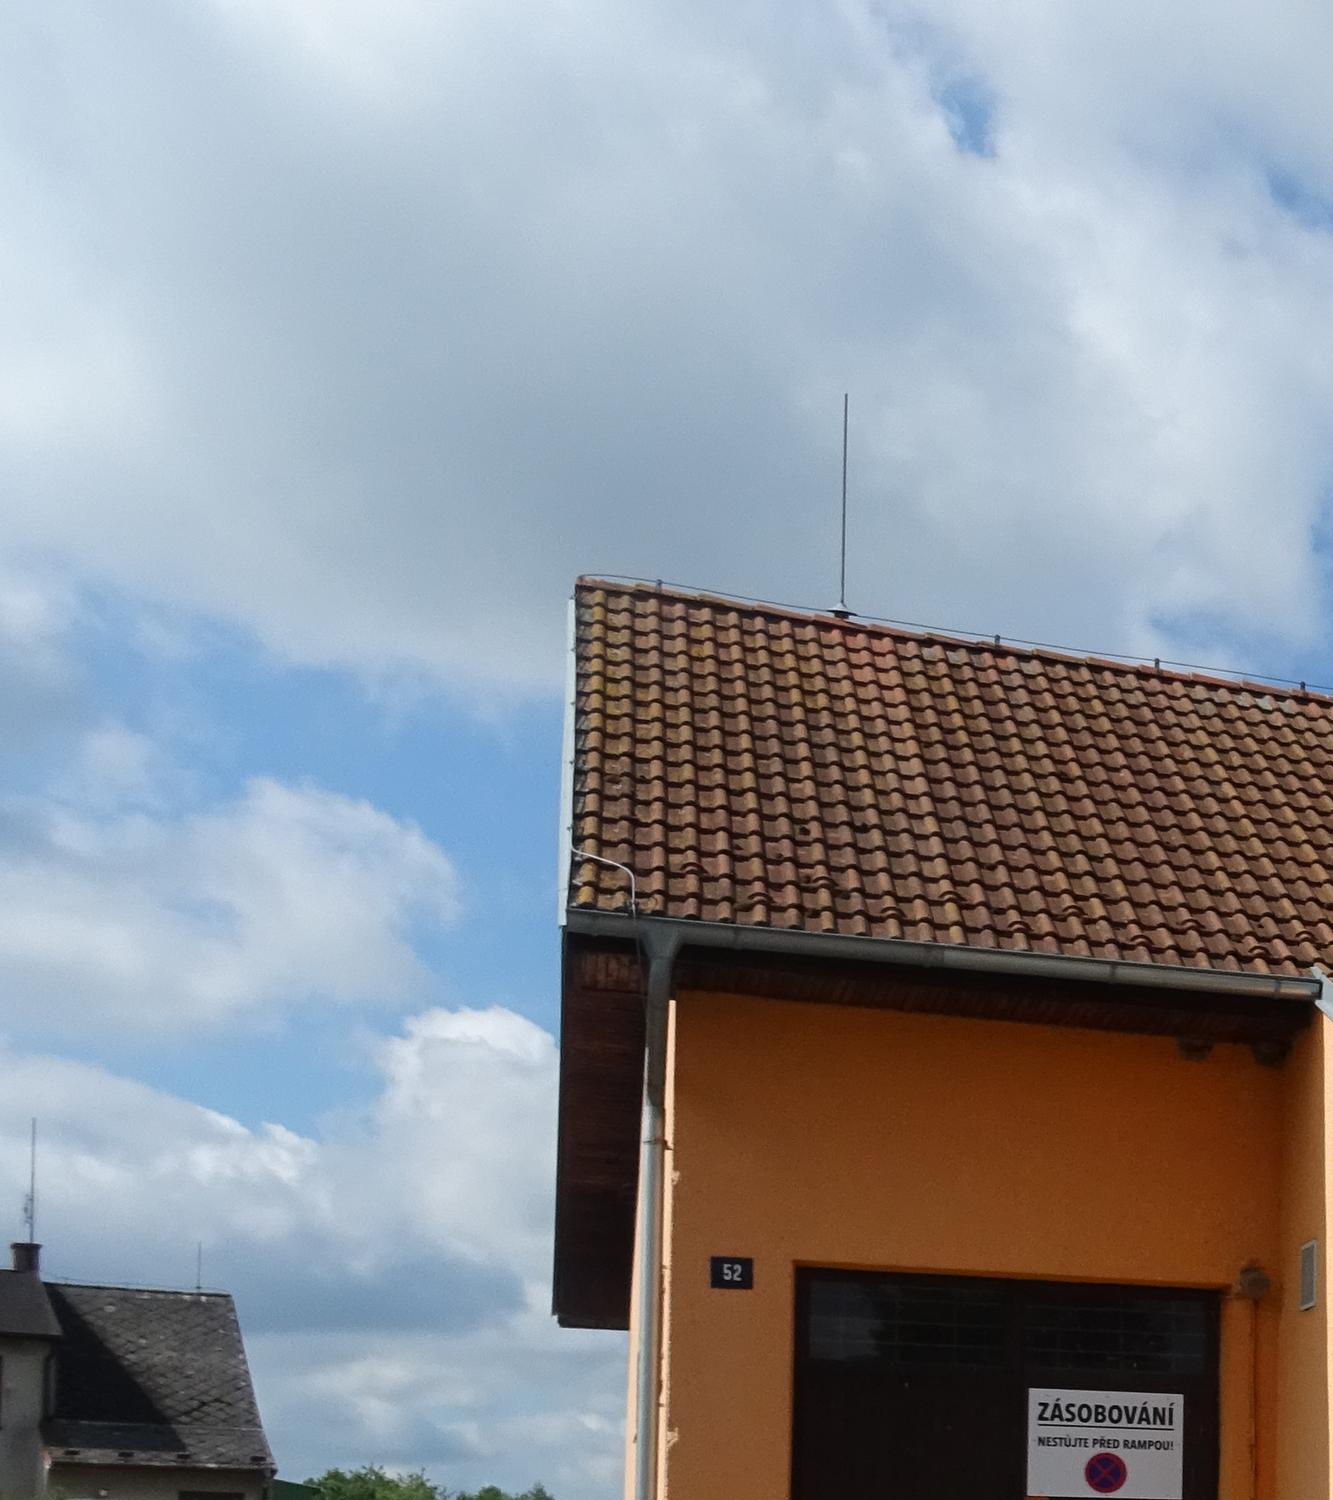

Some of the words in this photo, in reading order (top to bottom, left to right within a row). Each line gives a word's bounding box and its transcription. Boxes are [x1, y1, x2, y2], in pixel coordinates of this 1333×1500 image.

[723, 1263, 742, 1281] 52
[1037, 1398, 1175, 1426] ZÁSOBOVÁNÍ
[1037, 1434, 1090, 1448] NESTŮJTE
[1091, 1435, 1120, 1449] PŘED
[1122, 1438, 1175, 1451] RAMPOU!
